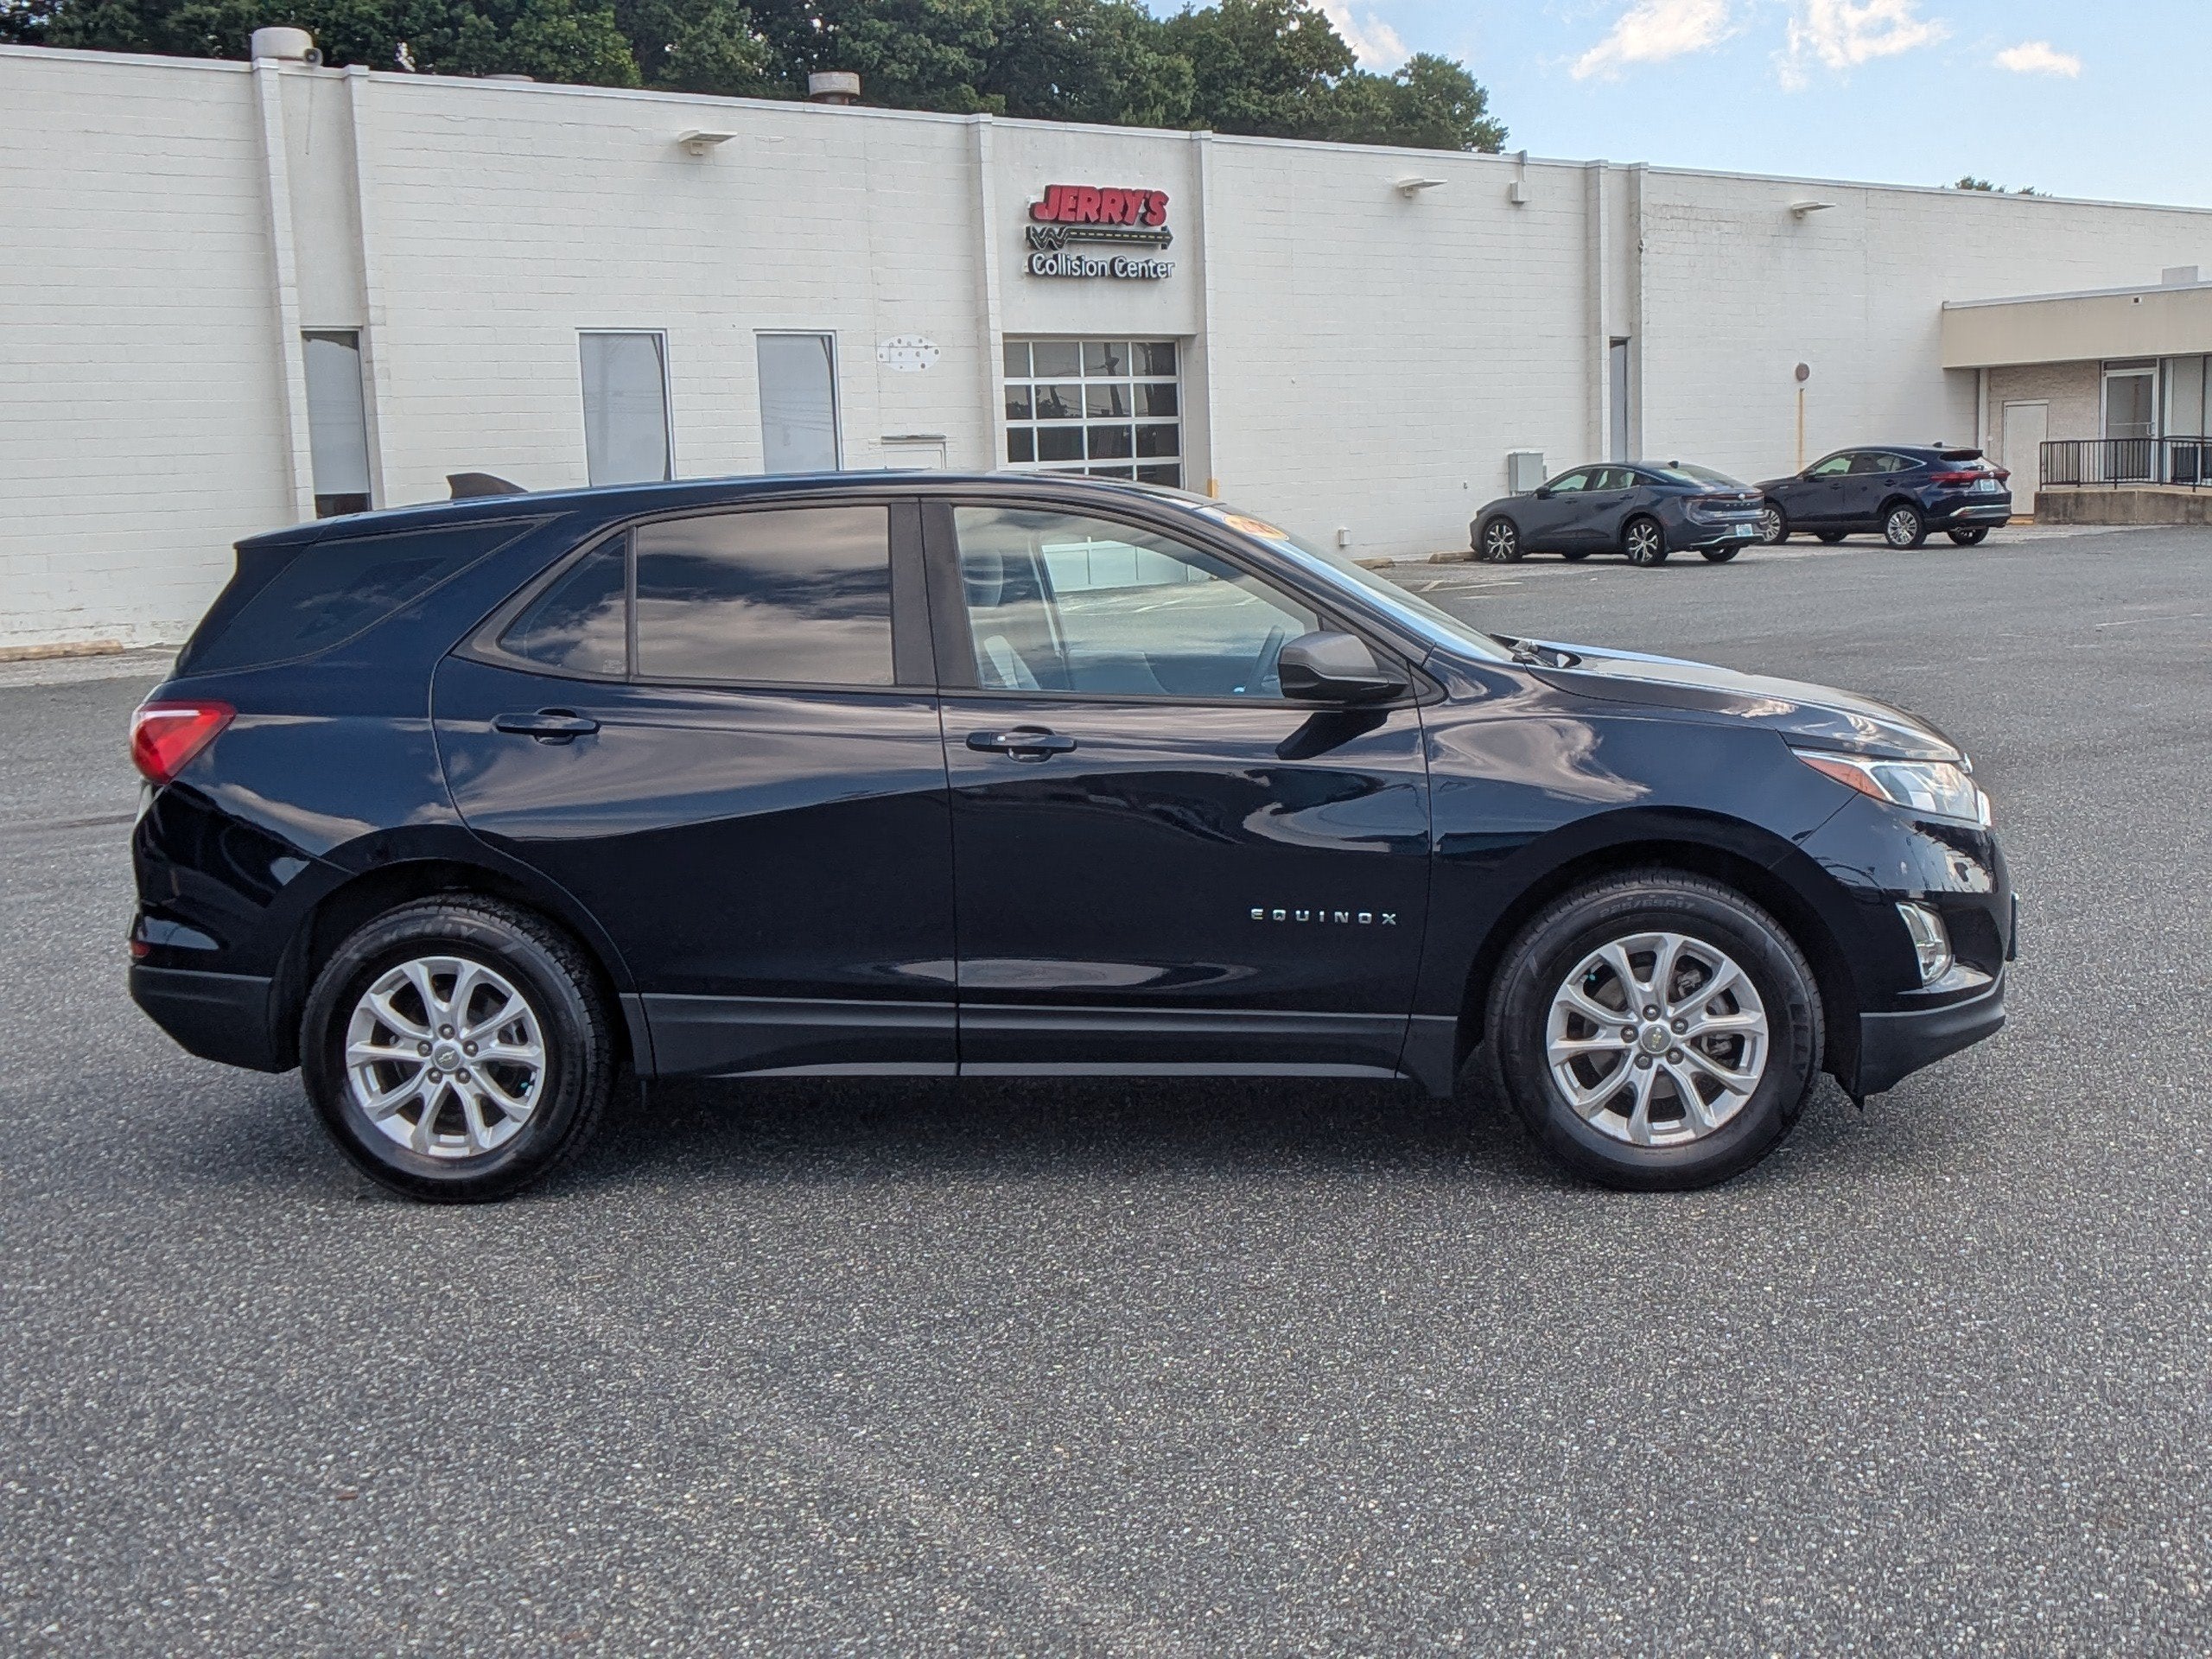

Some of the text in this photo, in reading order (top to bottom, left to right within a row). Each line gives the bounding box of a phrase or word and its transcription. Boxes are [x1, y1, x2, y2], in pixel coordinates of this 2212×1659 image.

[1029, 184, 1170, 226] JERRY'S
[1028, 253, 1175, 278] Collision Center
[1250, 908, 1397, 925] EQUINOX
